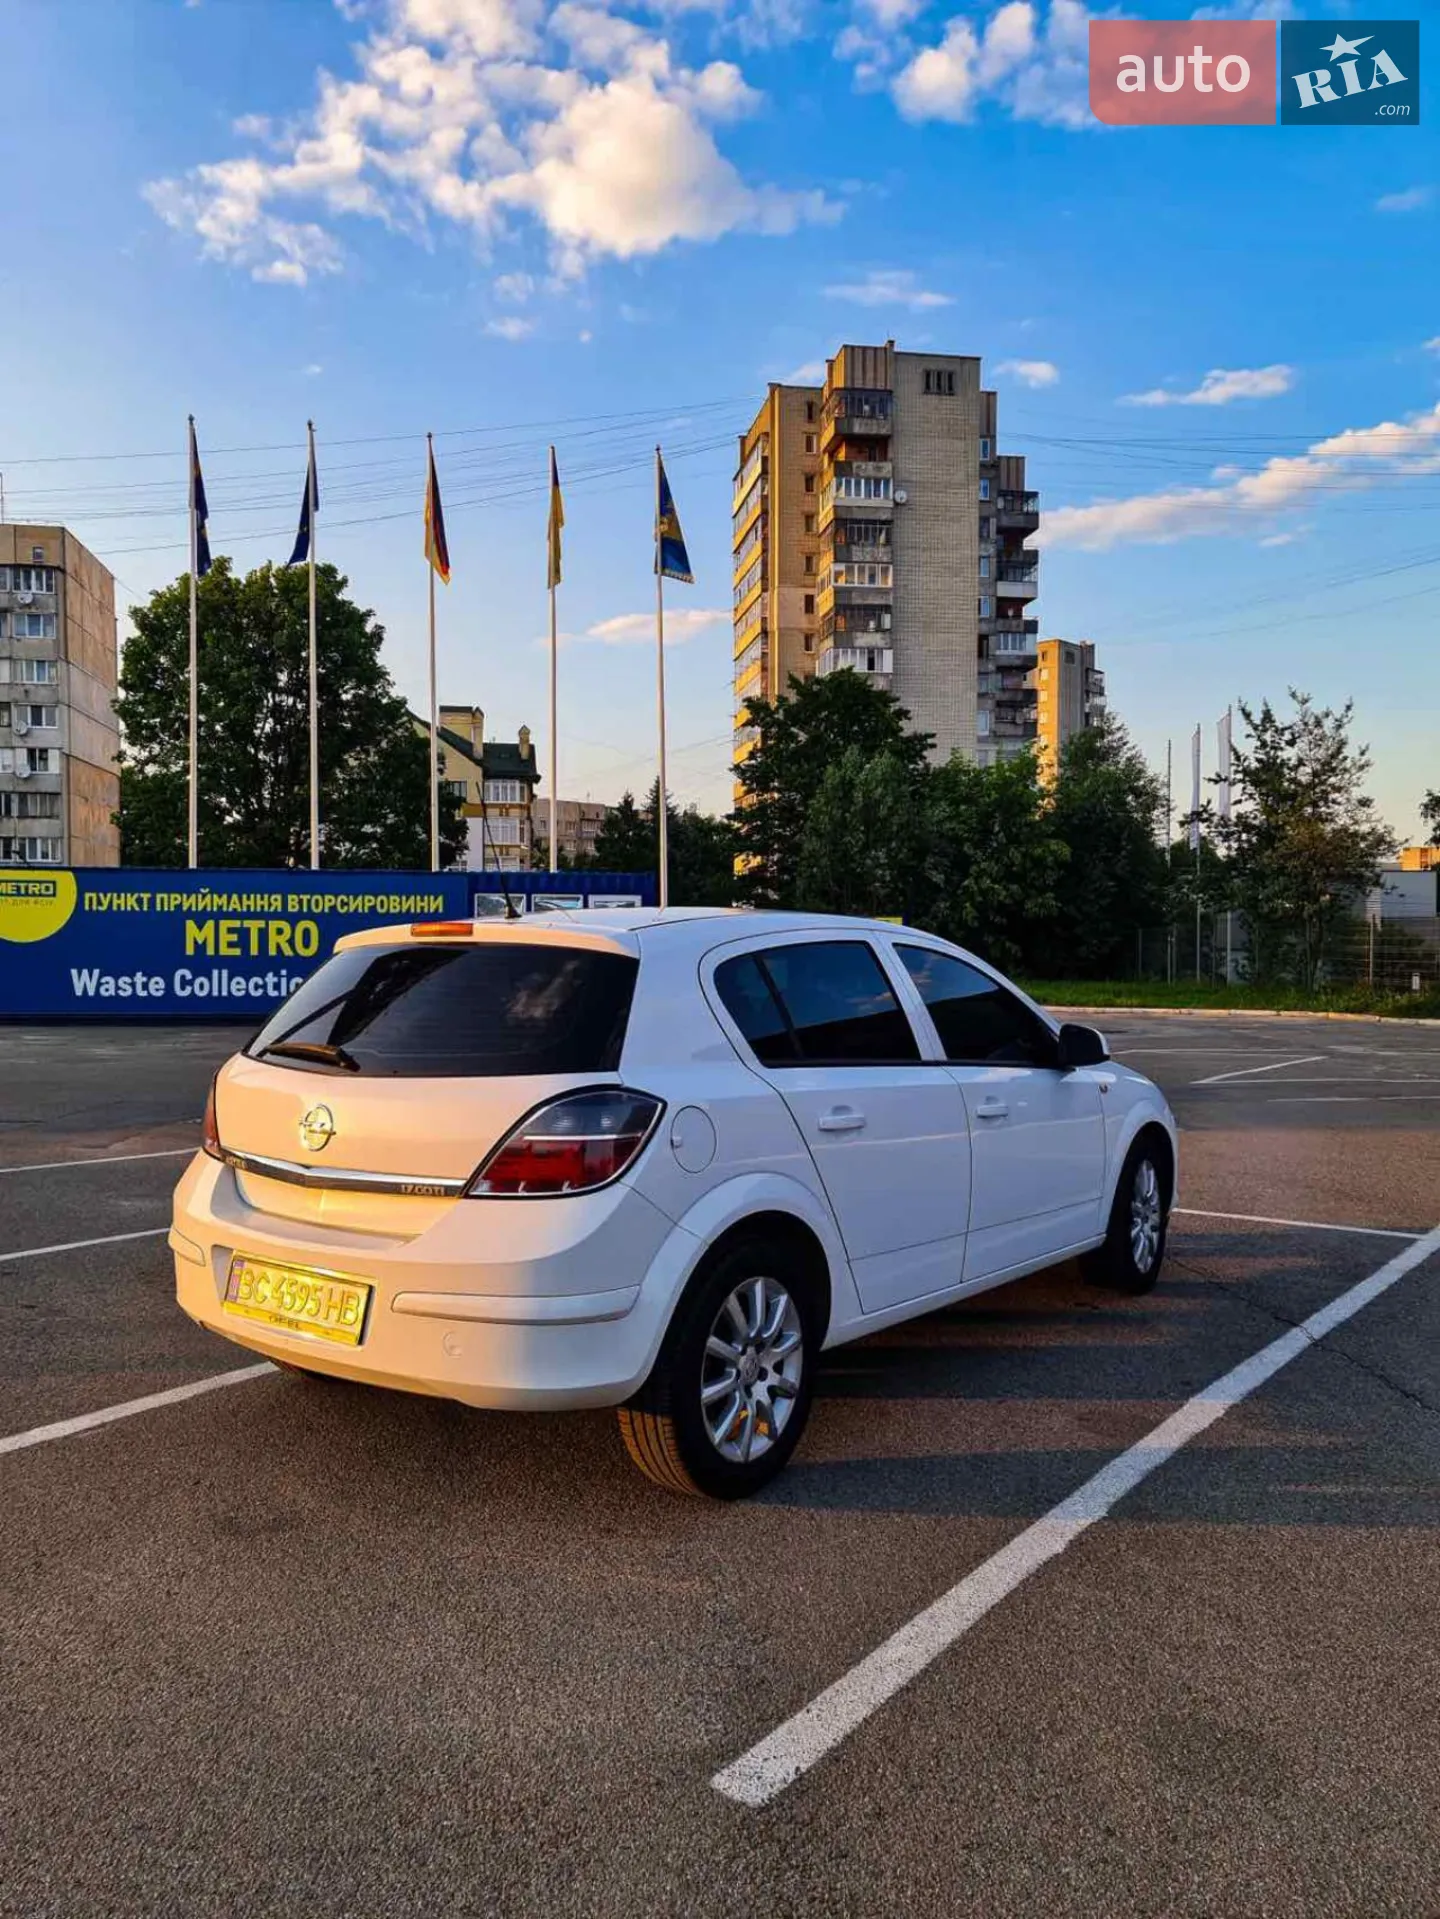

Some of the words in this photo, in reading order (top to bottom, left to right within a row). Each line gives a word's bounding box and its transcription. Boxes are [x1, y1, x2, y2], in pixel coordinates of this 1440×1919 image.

[84, 891, 152, 912] ПУНКТ
[156, 888, 283, 913] ПРИЙМАННЯ
[288, 892, 444, 914] ВТОРСИРОВИНИ
[184, 919, 320, 958] METRO
[71, 967, 166, 998] Waste
